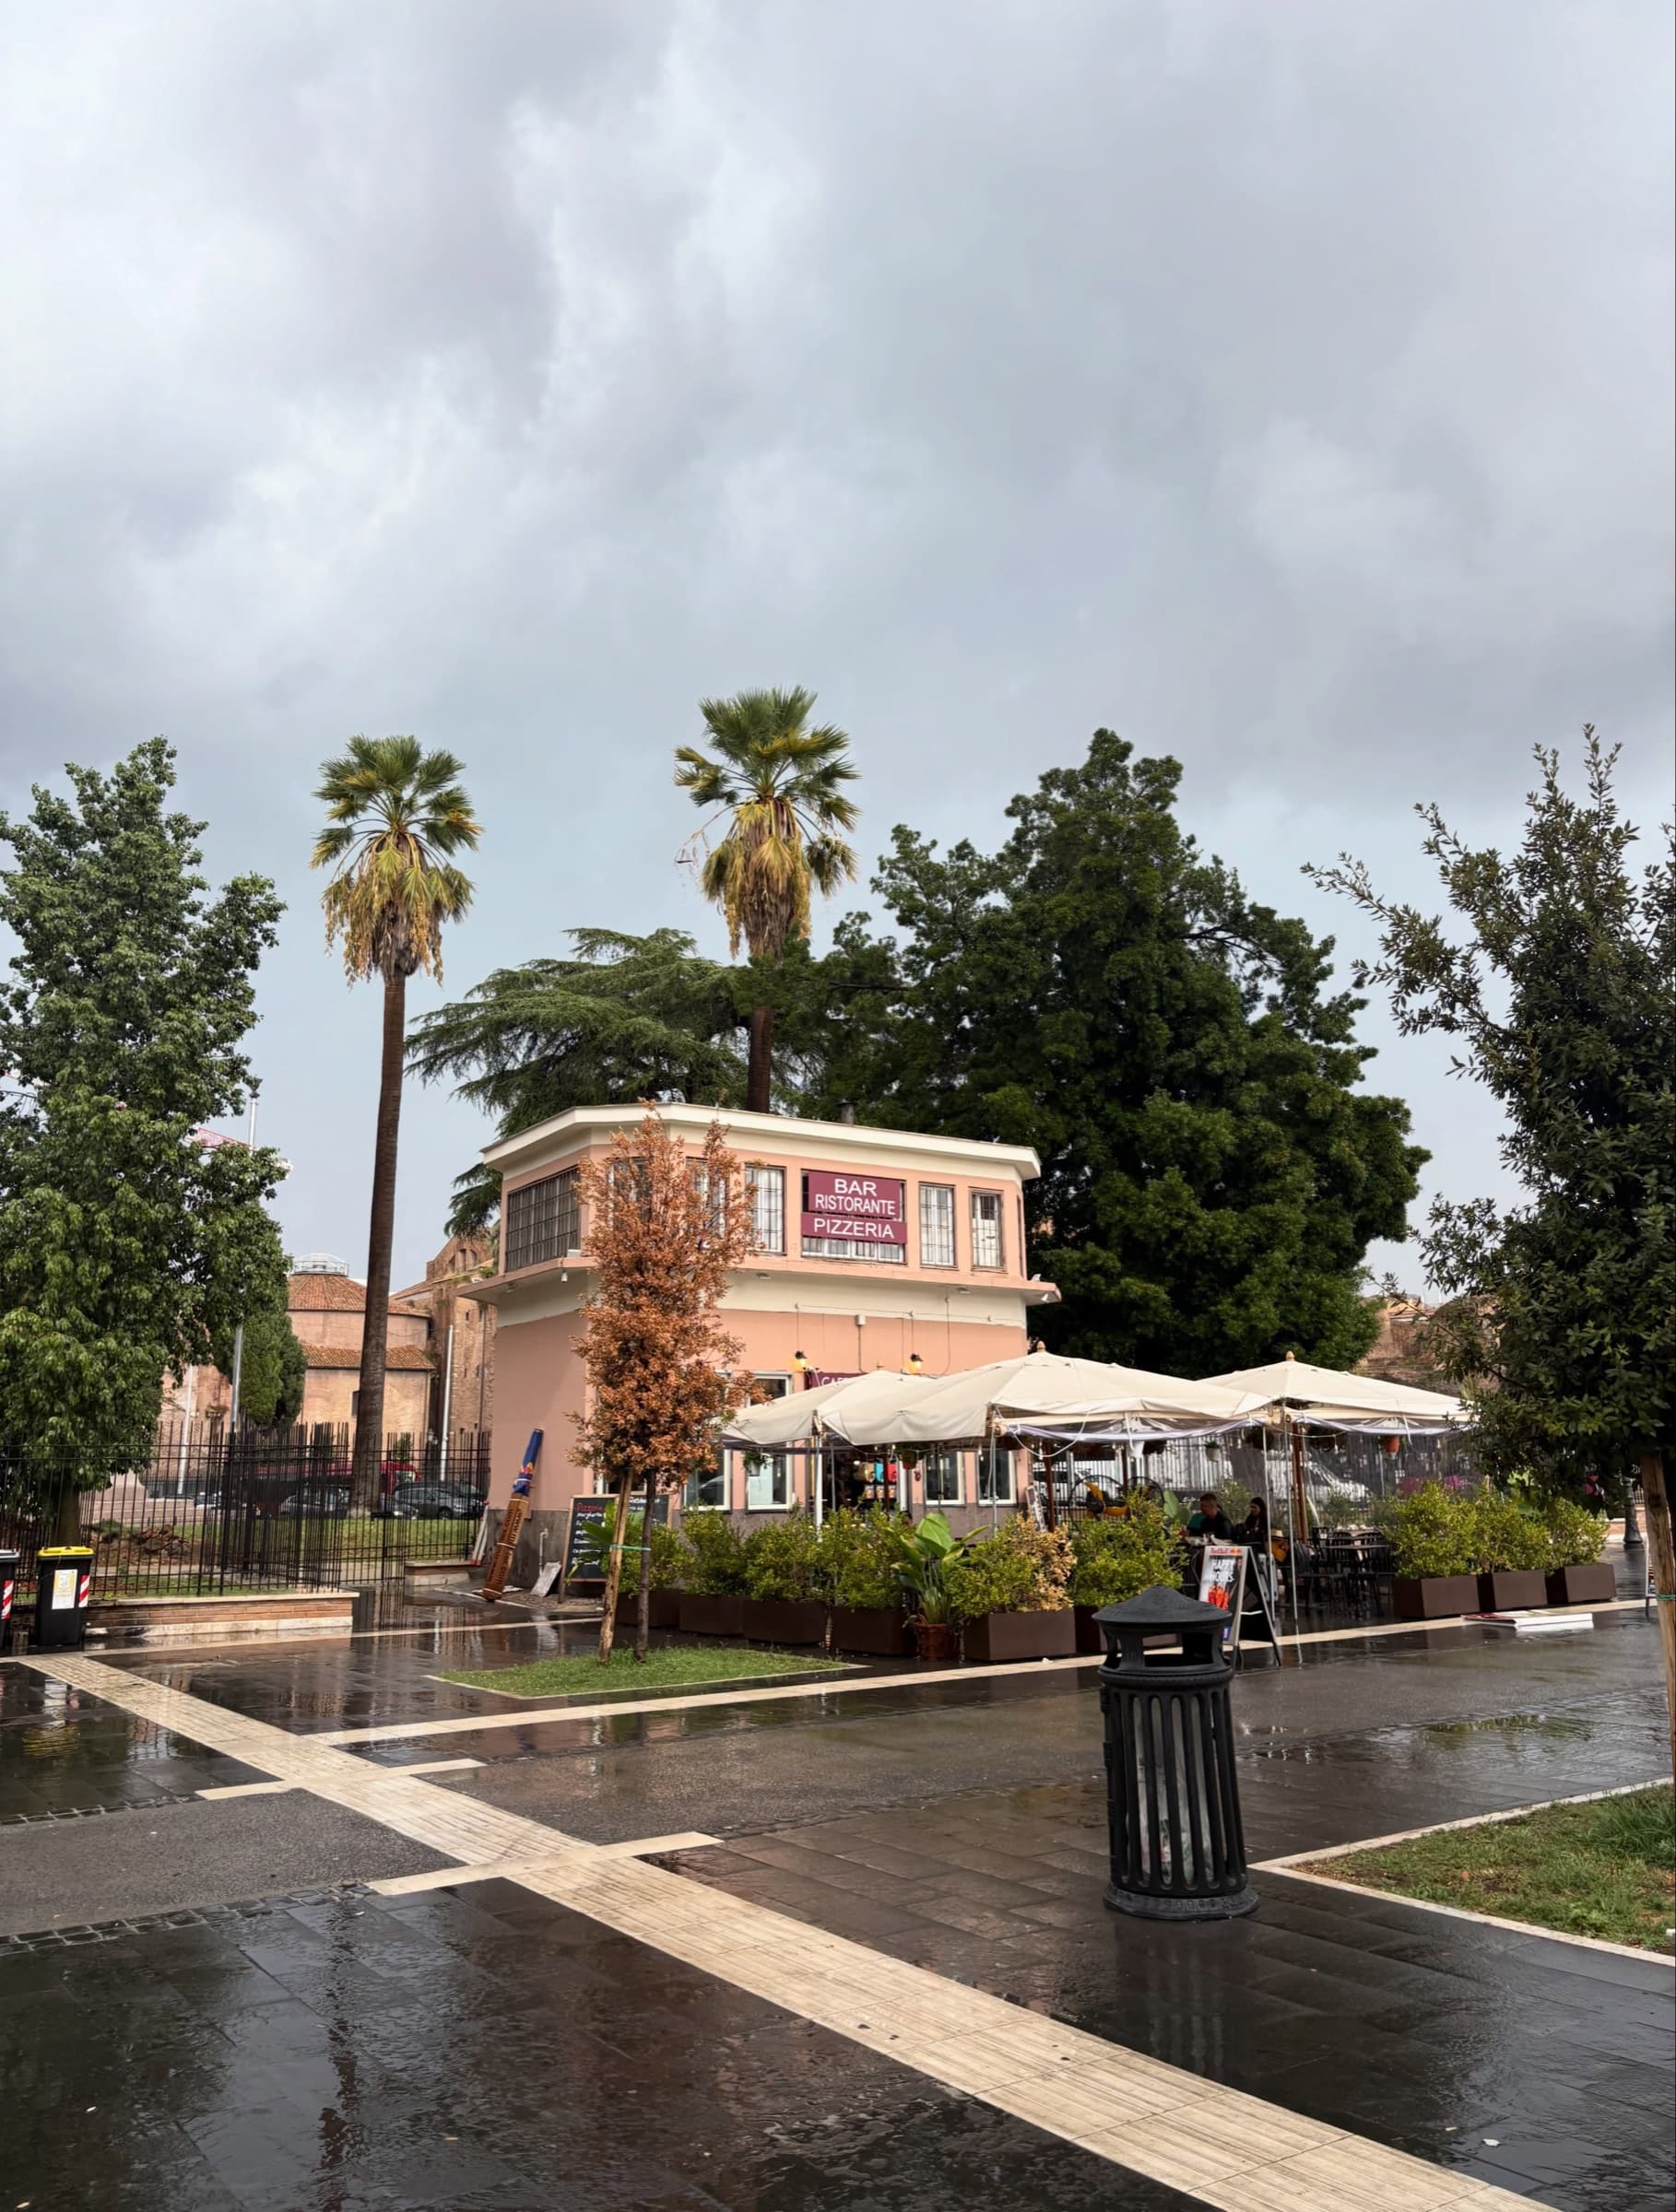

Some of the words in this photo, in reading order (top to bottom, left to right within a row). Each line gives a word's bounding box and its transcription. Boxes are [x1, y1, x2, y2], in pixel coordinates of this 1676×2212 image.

[834, 1179, 877, 1197] BAR
[815, 1194, 895, 1215] RISTORANTE
[814, 1218, 894, 1239] PIZZERIA
